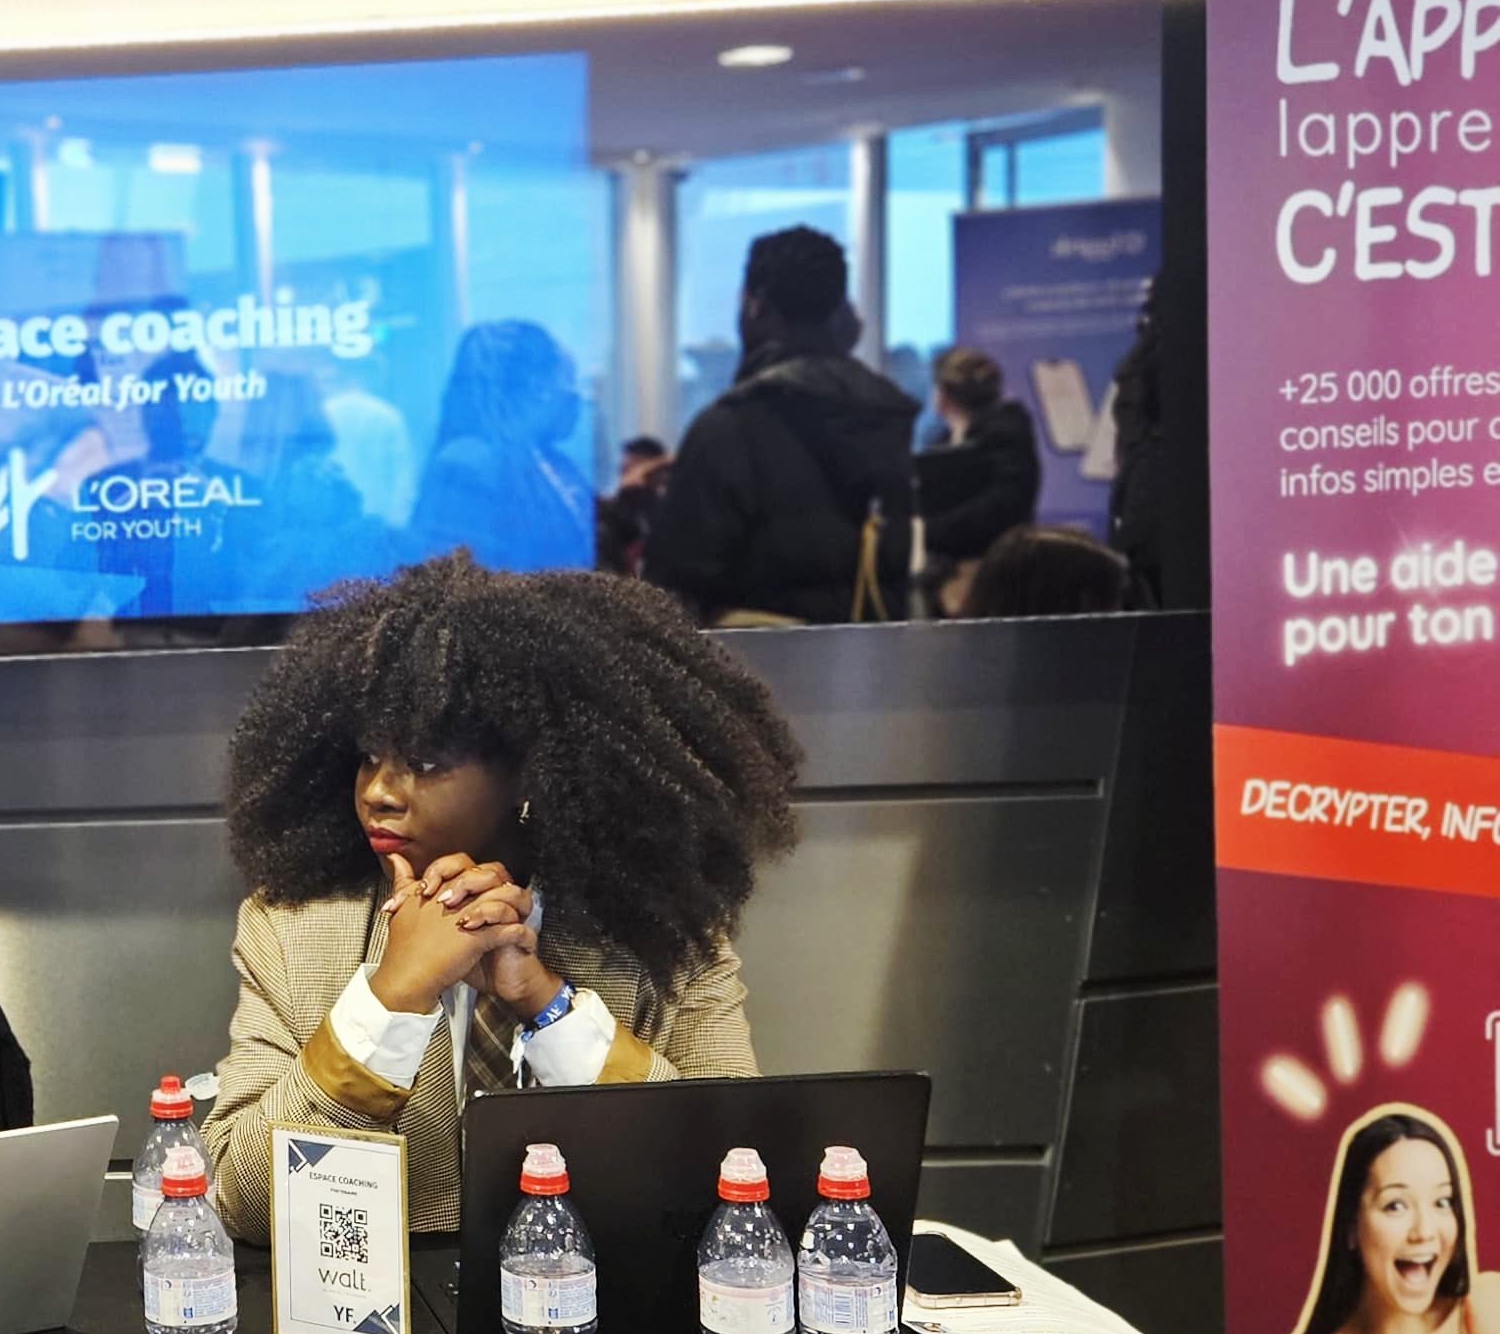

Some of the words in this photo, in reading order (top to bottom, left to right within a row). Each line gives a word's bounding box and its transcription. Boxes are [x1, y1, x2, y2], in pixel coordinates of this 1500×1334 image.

[1279, 98, 1493, 169] lappre
[1276, 180, 1500, 284] C'EST
[101, 288, 373, 359] coaching
[3, 374, 112, 412] L'Oréal
[115, 374, 168, 411] for
[174, 371, 268, 402] Youth
[1279, 371, 1339, 404] +25
[1347, 368, 1402, 402] 000
[1409, 364, 1500, 399] offres
[1279, 413, 1401, 452] conseils
[1407, 417, 1480, 452] pour
[71, 471, 262, 514] L'ORÉAL
[1280, 463, 1357, 498] infos
[1363, 457, 1475, 498] simples
[71, 521, 118, 542] FOR
[121, 517, 202, 539] YOUTH
[1282, 551, 1379, 598] Une
[1391, 539, 1498, 591] aide
[1284, 610, 1396, 667] pour
[1408, 603, 1495, 645] ton
[1240, 778, 1432, 841] DECRYPTER,
[309, 1171, 337, 1183] ESPACE
[338, 1176, 379, 1189] COACHING
[333, 1305, 357, 1324] YF.
